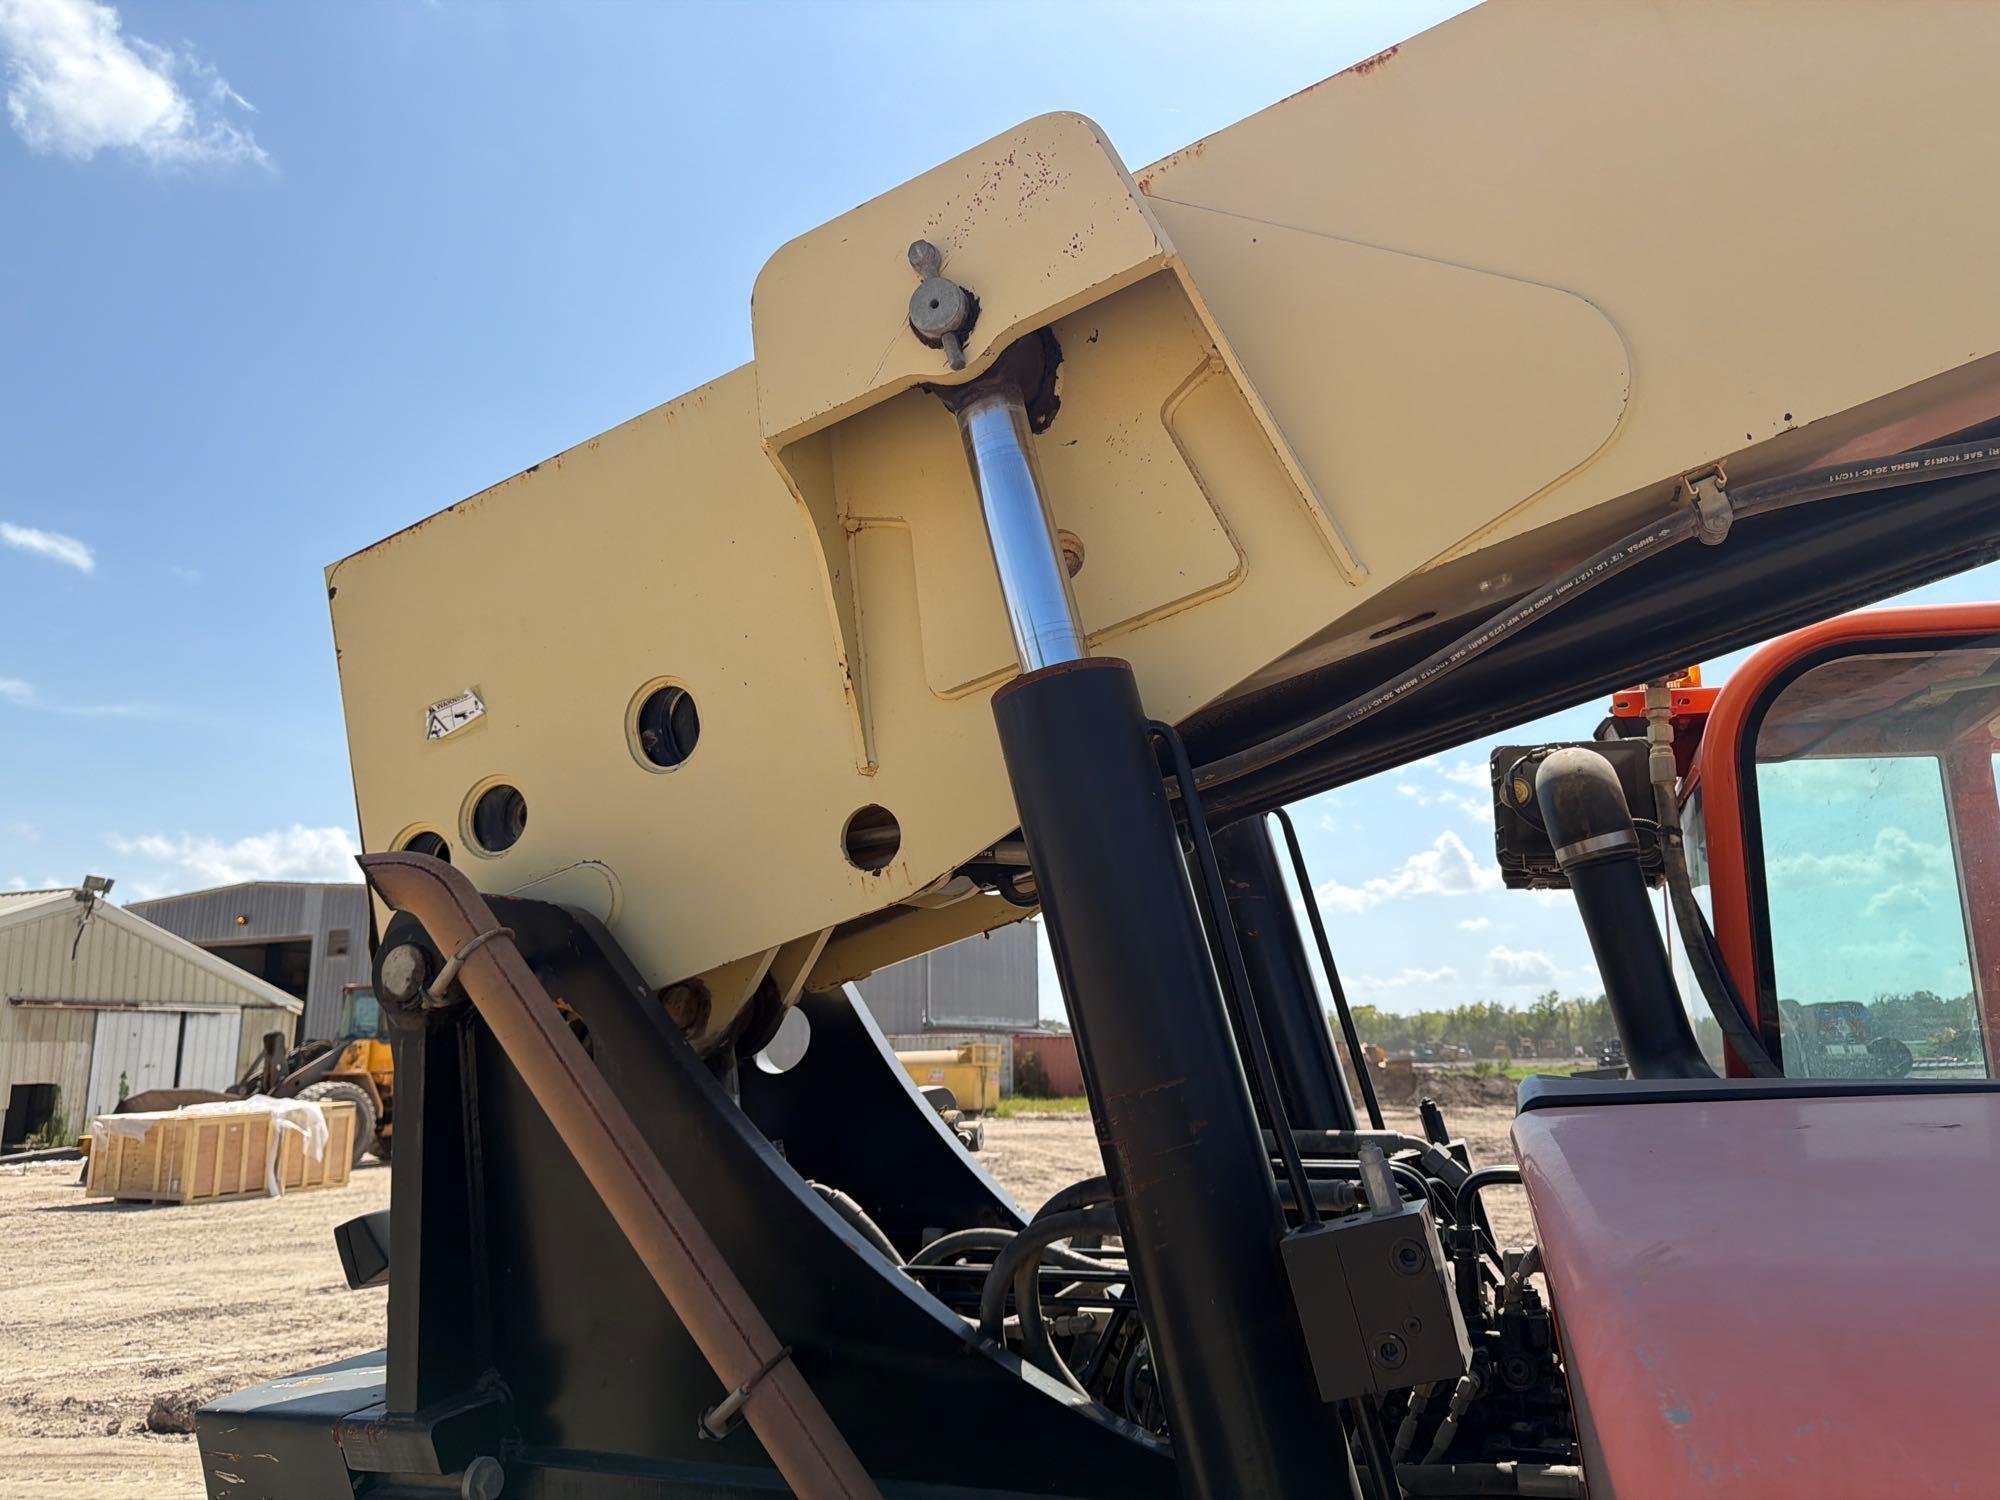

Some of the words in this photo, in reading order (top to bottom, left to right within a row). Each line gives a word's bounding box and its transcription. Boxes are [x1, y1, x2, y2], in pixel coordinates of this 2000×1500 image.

[1924, 455, 1960, 467] 100R12
[1963, 450, 1984, 461] SAE
[1891, 461, 1919, 472] MSHA
[1535, 594, 1553, 609] 4000
[1519, 607, 1534, 620] PSI
[1507, 616, 1520, 628] WP
[1449, 649, 1467, 663] SAE
[1396, 677, 1419, 695] MSHA
